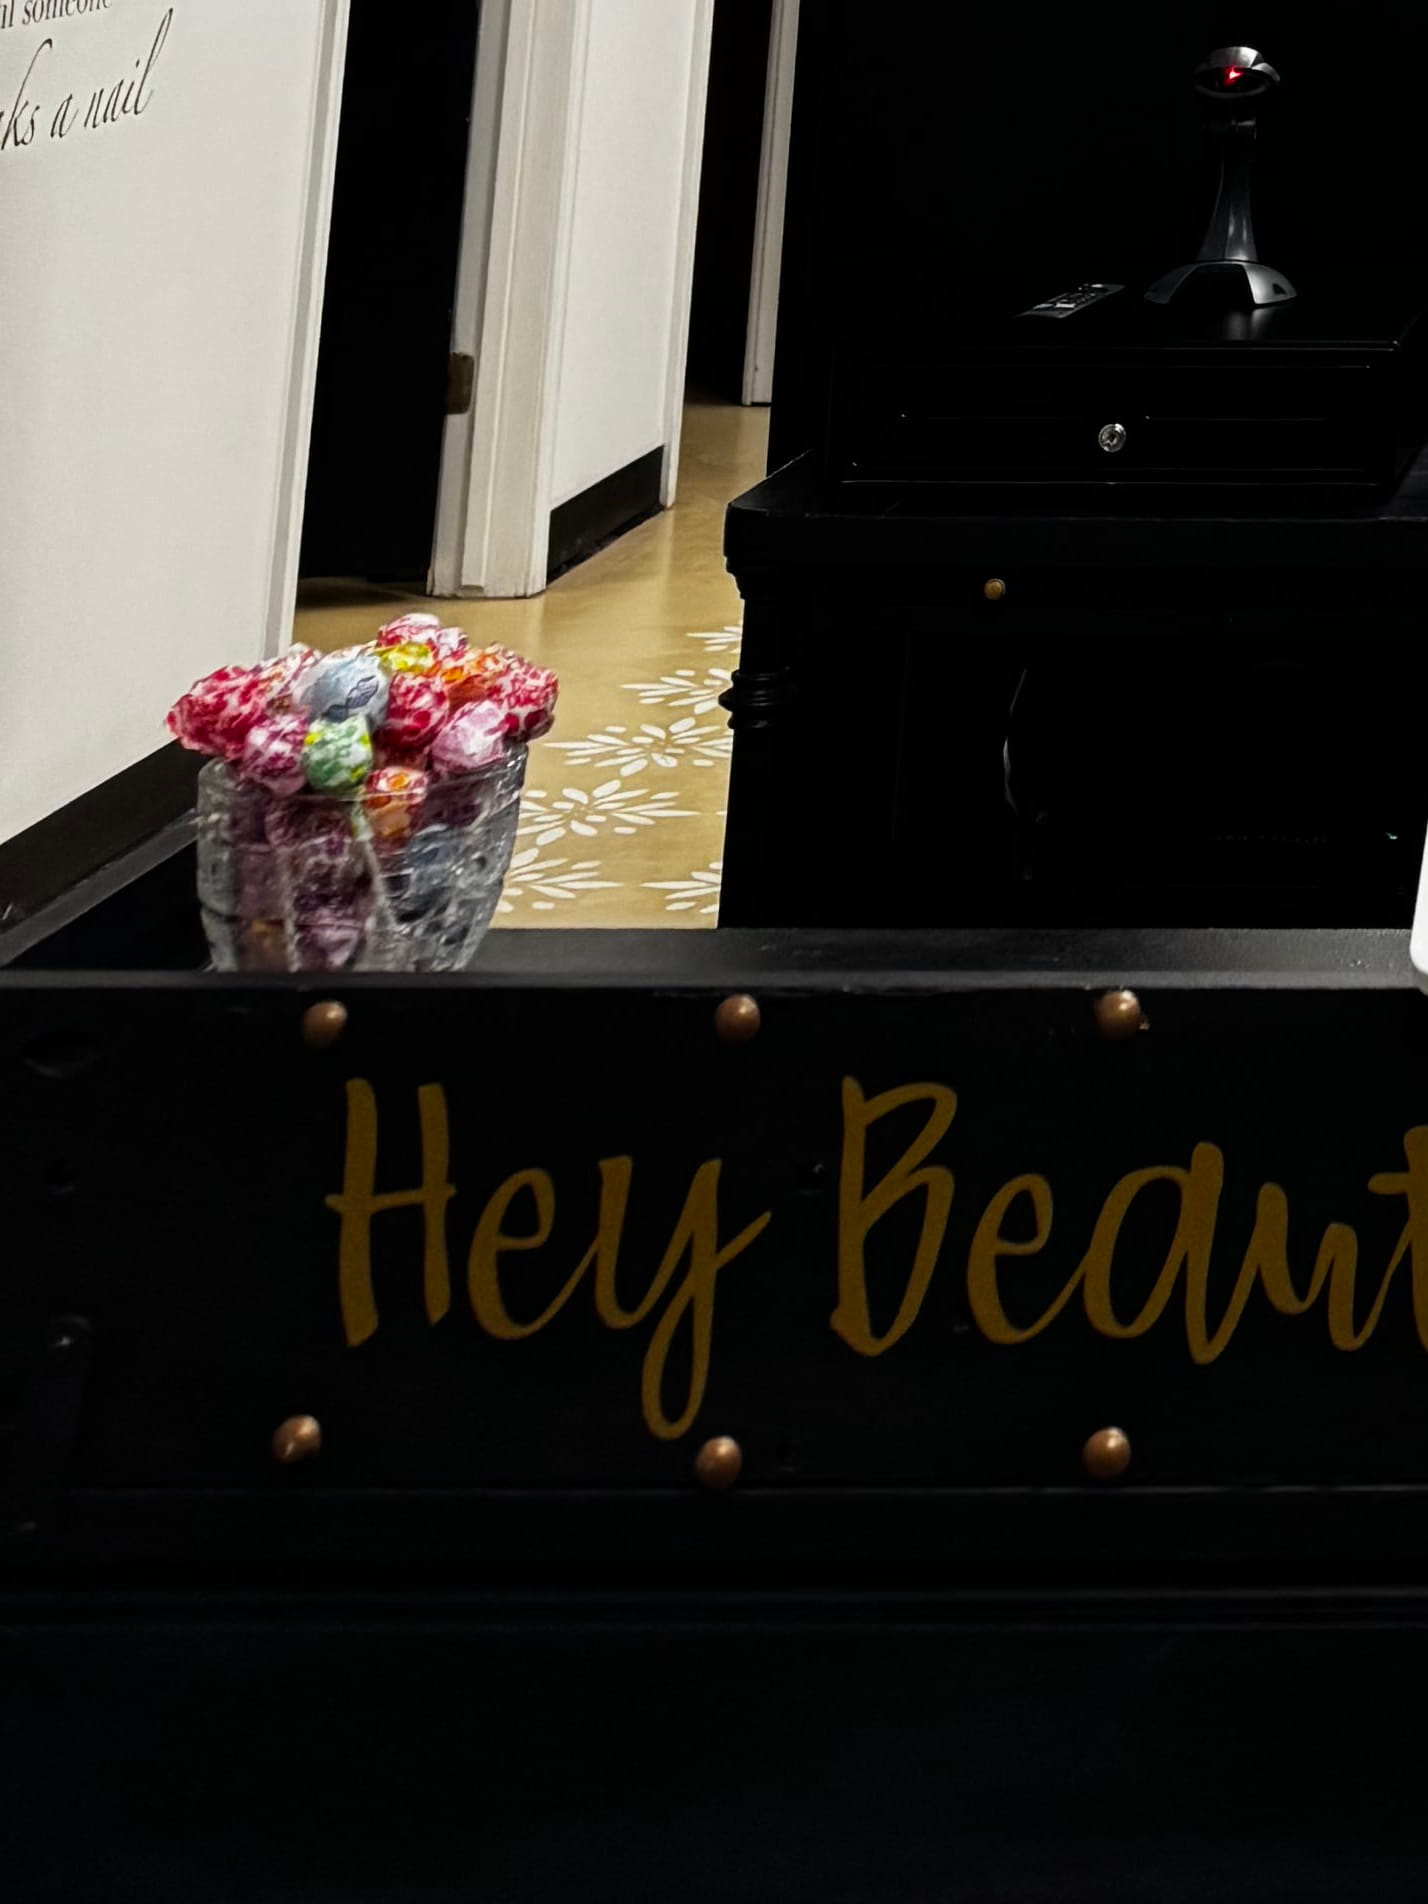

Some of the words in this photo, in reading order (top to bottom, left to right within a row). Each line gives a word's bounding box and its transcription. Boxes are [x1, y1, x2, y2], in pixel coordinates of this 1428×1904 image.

[50, 94, 79, 138] a
[84, 7, 173, 128] nail
[326, 1078, 772, 1440] Hey
